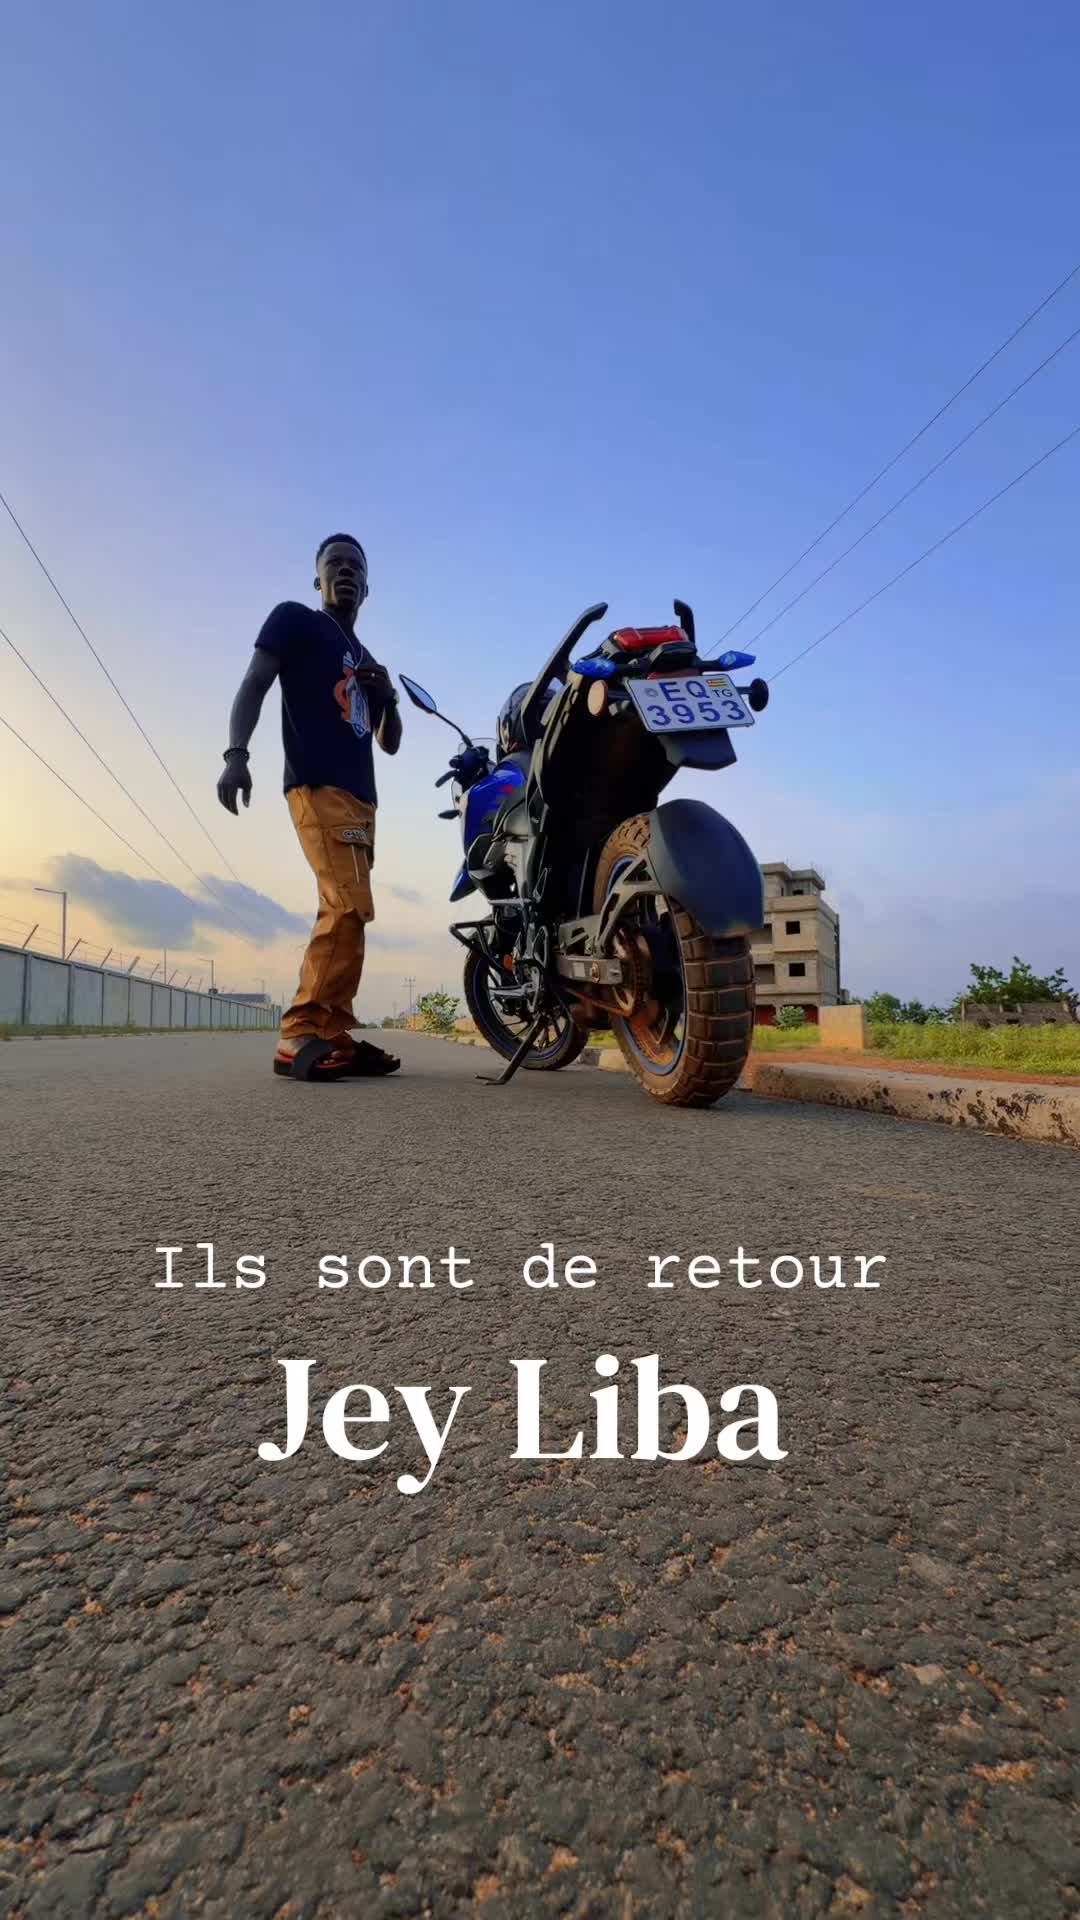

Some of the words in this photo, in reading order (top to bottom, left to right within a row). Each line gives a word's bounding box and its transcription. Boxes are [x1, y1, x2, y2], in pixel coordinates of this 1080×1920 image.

[658, 680, 710, 702] EQ
[712, 688, 733, 698] TG
[647, 700, 746, 727] 3953
